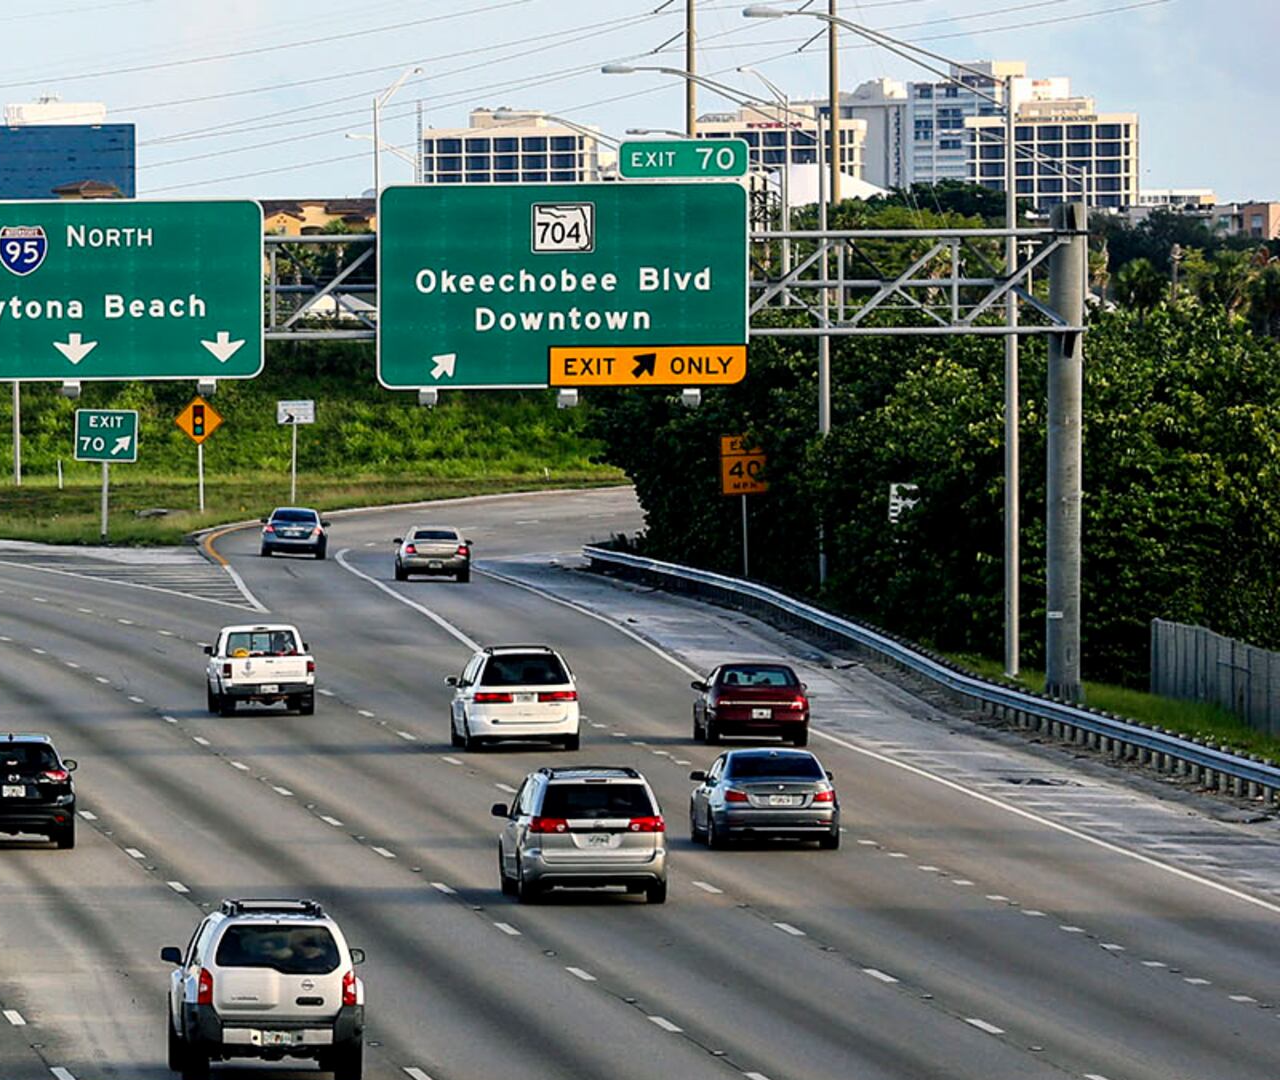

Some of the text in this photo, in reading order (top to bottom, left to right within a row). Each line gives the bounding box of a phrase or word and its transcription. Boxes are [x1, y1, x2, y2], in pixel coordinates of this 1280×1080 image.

[631, 148, 736, 170] EXIT 70
[5, 225, 153, 263] 95 NORTH
[537, 222, 581, 244] 704
[415, 267, 711, 294] Okeechobee Blvd
[104, 294, 206, 319] Beach
[475, 306, 651, 332] Downtown
[564, 356, 733, 376] EXIT ONLY
[89, 415, 124, 429] EXIT
[79, 436, 105, 451] 70
[729, 460, 761, 479] 40
